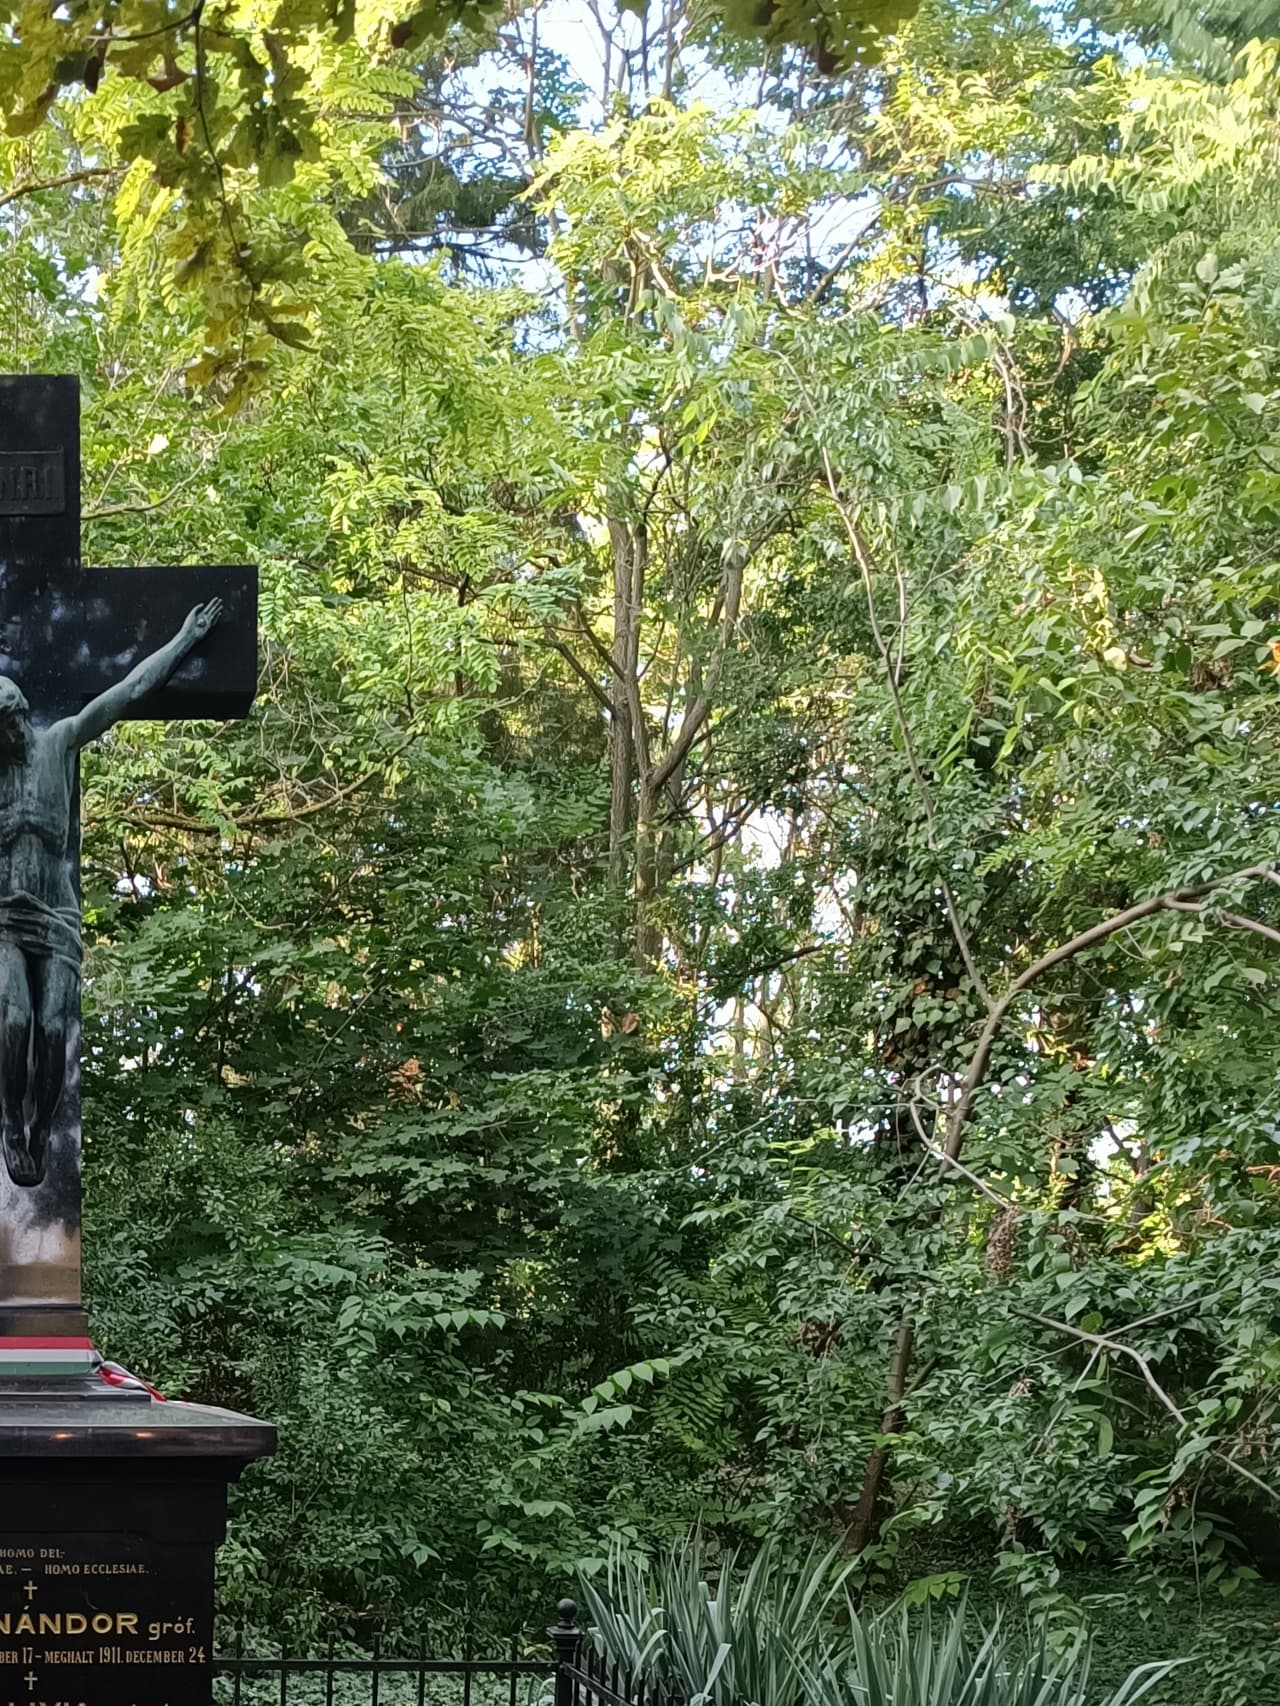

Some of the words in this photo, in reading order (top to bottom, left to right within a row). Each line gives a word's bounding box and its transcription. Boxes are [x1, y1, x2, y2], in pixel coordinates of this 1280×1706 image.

[0, 1548, 35, 1558] HOMO
[44, 1564, 80, 1575] HOMO
[44, 1650, 95, 1664] MEGHALT
[125, 1650, 185, 1664] DECEMBER
